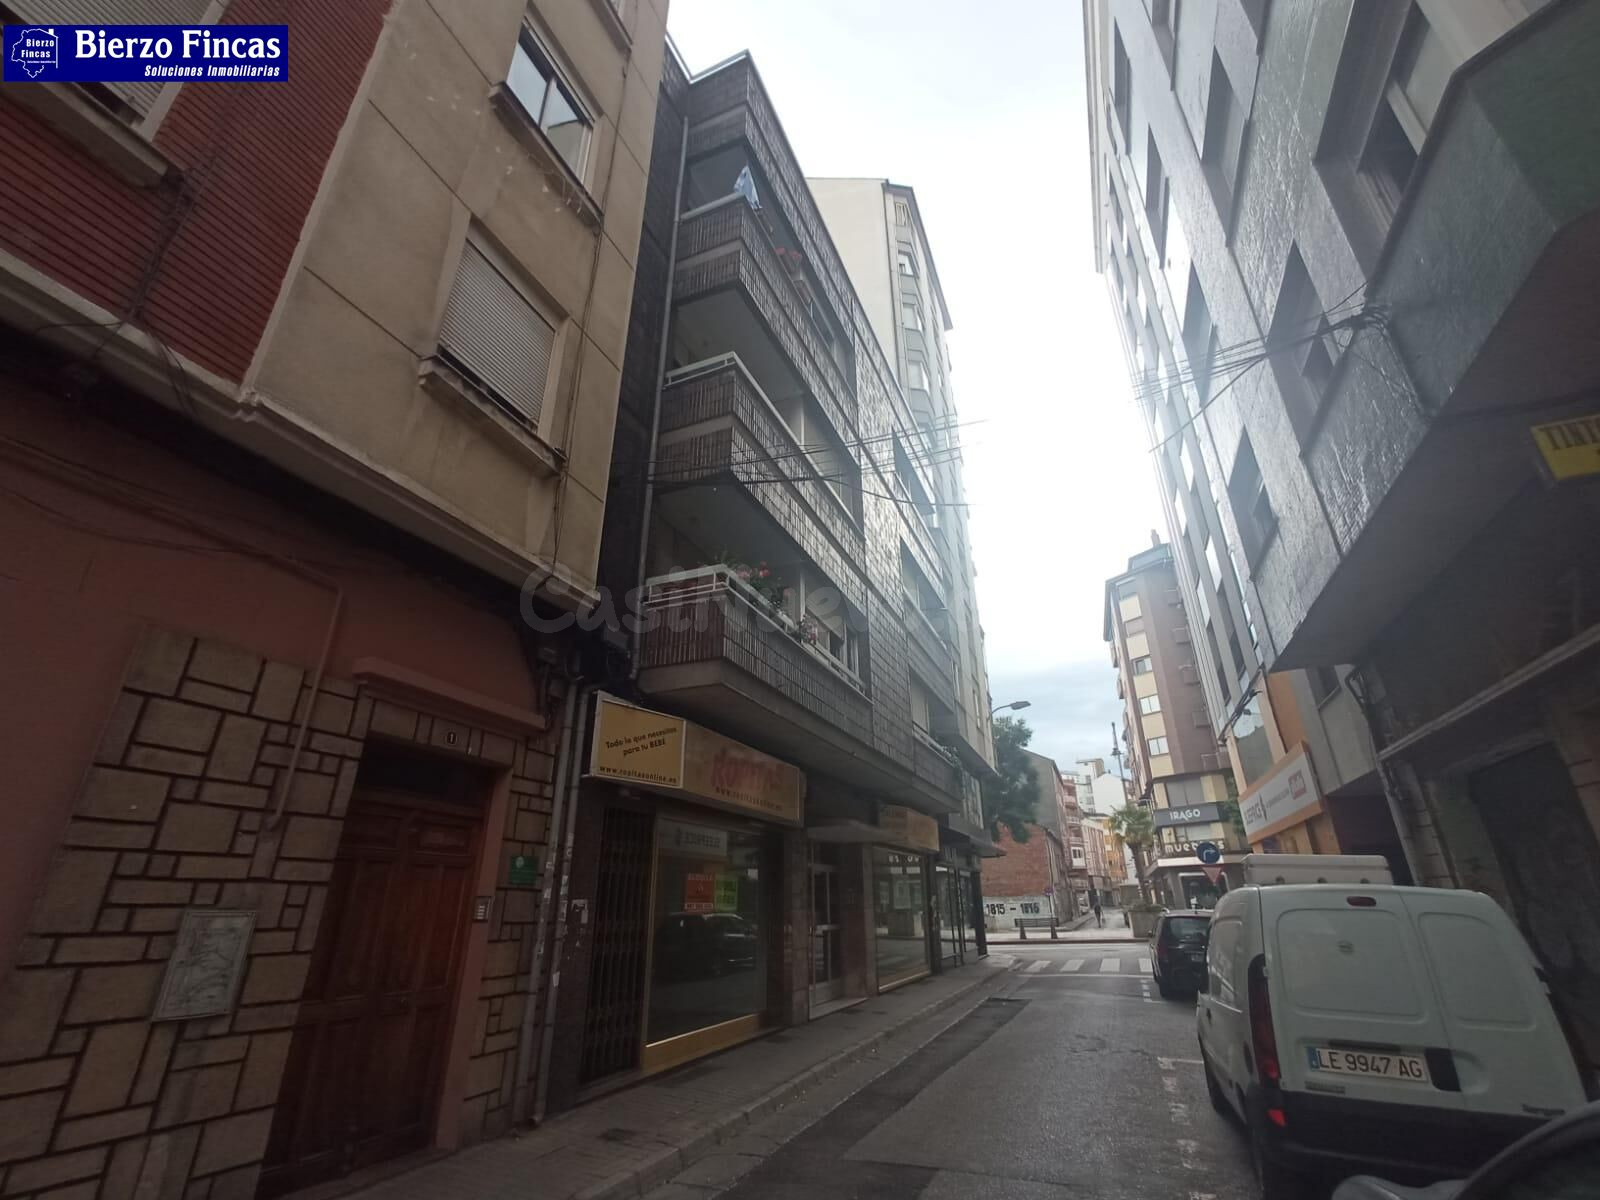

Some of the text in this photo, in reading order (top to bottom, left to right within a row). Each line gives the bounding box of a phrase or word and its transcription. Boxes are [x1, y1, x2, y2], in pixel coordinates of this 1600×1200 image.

[605, 738, 624, 749] Todo
[633, 734, 646, 743] que
[623, 745, 640, 756] para
[1169, 808, 1201, 821] IRAGO
[986, 903, 1006, 915] 1815
[1317, 1050, 1423, 1078] LE 9947 AG
